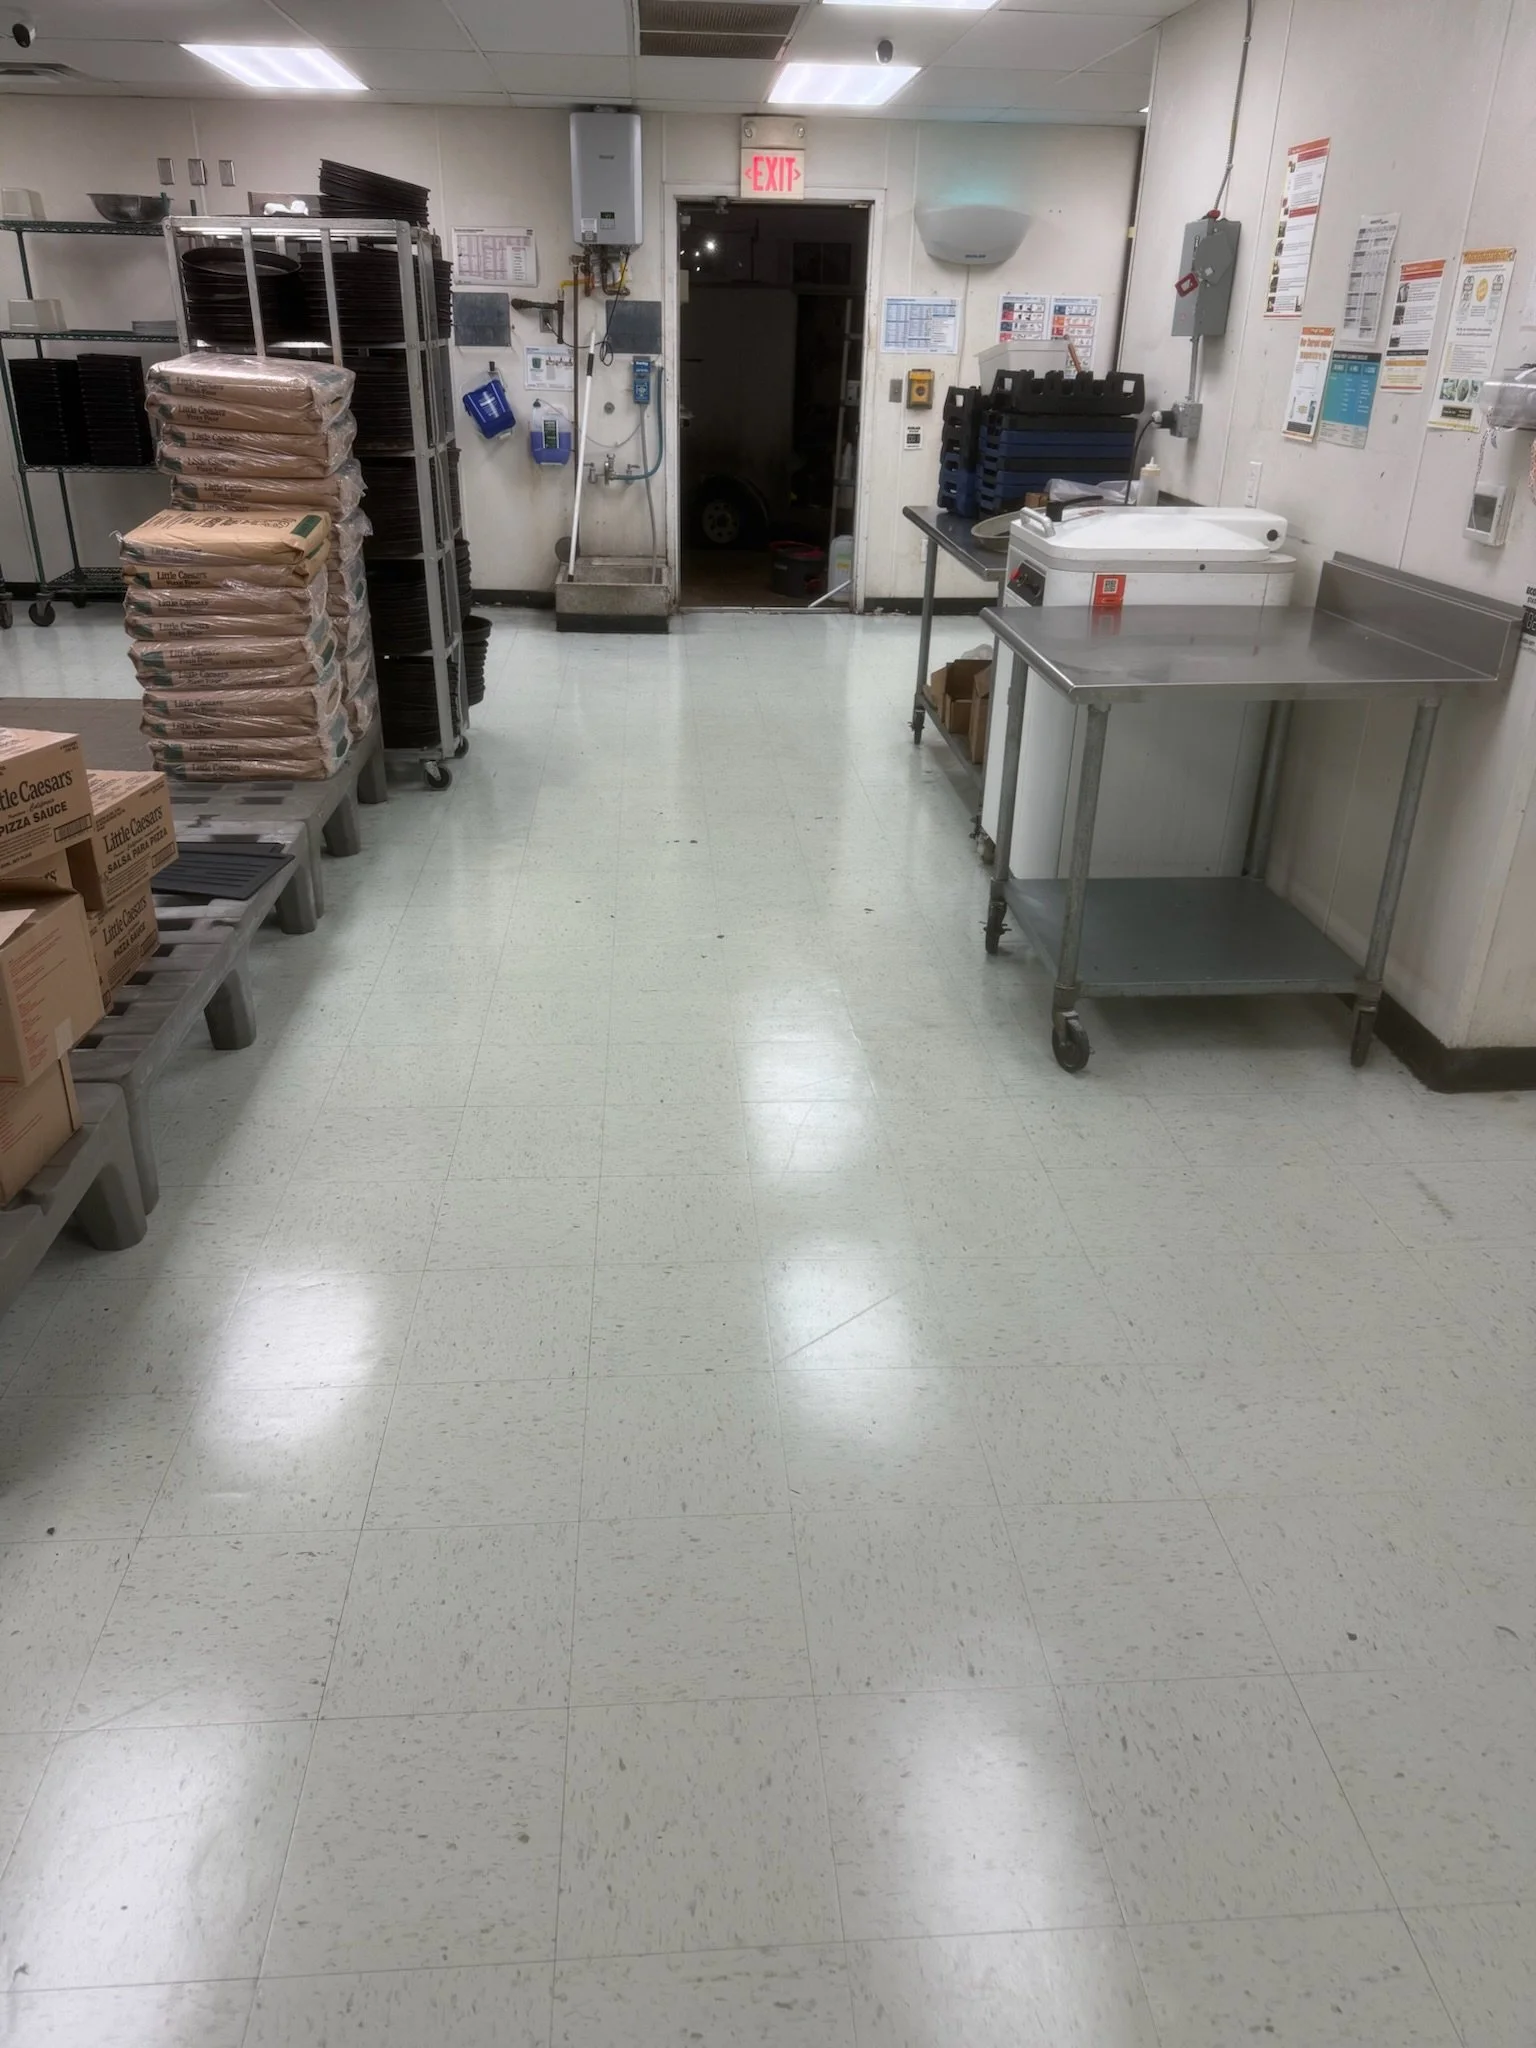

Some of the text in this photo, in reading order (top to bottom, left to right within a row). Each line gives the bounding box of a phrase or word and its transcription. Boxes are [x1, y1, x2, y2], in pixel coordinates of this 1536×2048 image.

[753, 156, 796, 191] EXIT
[157, 570, 208, 580] Little Caesars
[19, 770, 73, 803] Caesars
[0, 801, 68, 837] PIZZA SAUCE
[103, 825, 131, 854] Little
[129, 805, 163, 837] Caesars
[107, 853, 132, 874] SALSA
[132, 840, 150, 860] PARA
[149, 827, 168, 846] PIZZA
[102, 895, 147, 947] Little Caesars
[113, 938, 131, 959] PIZZA
